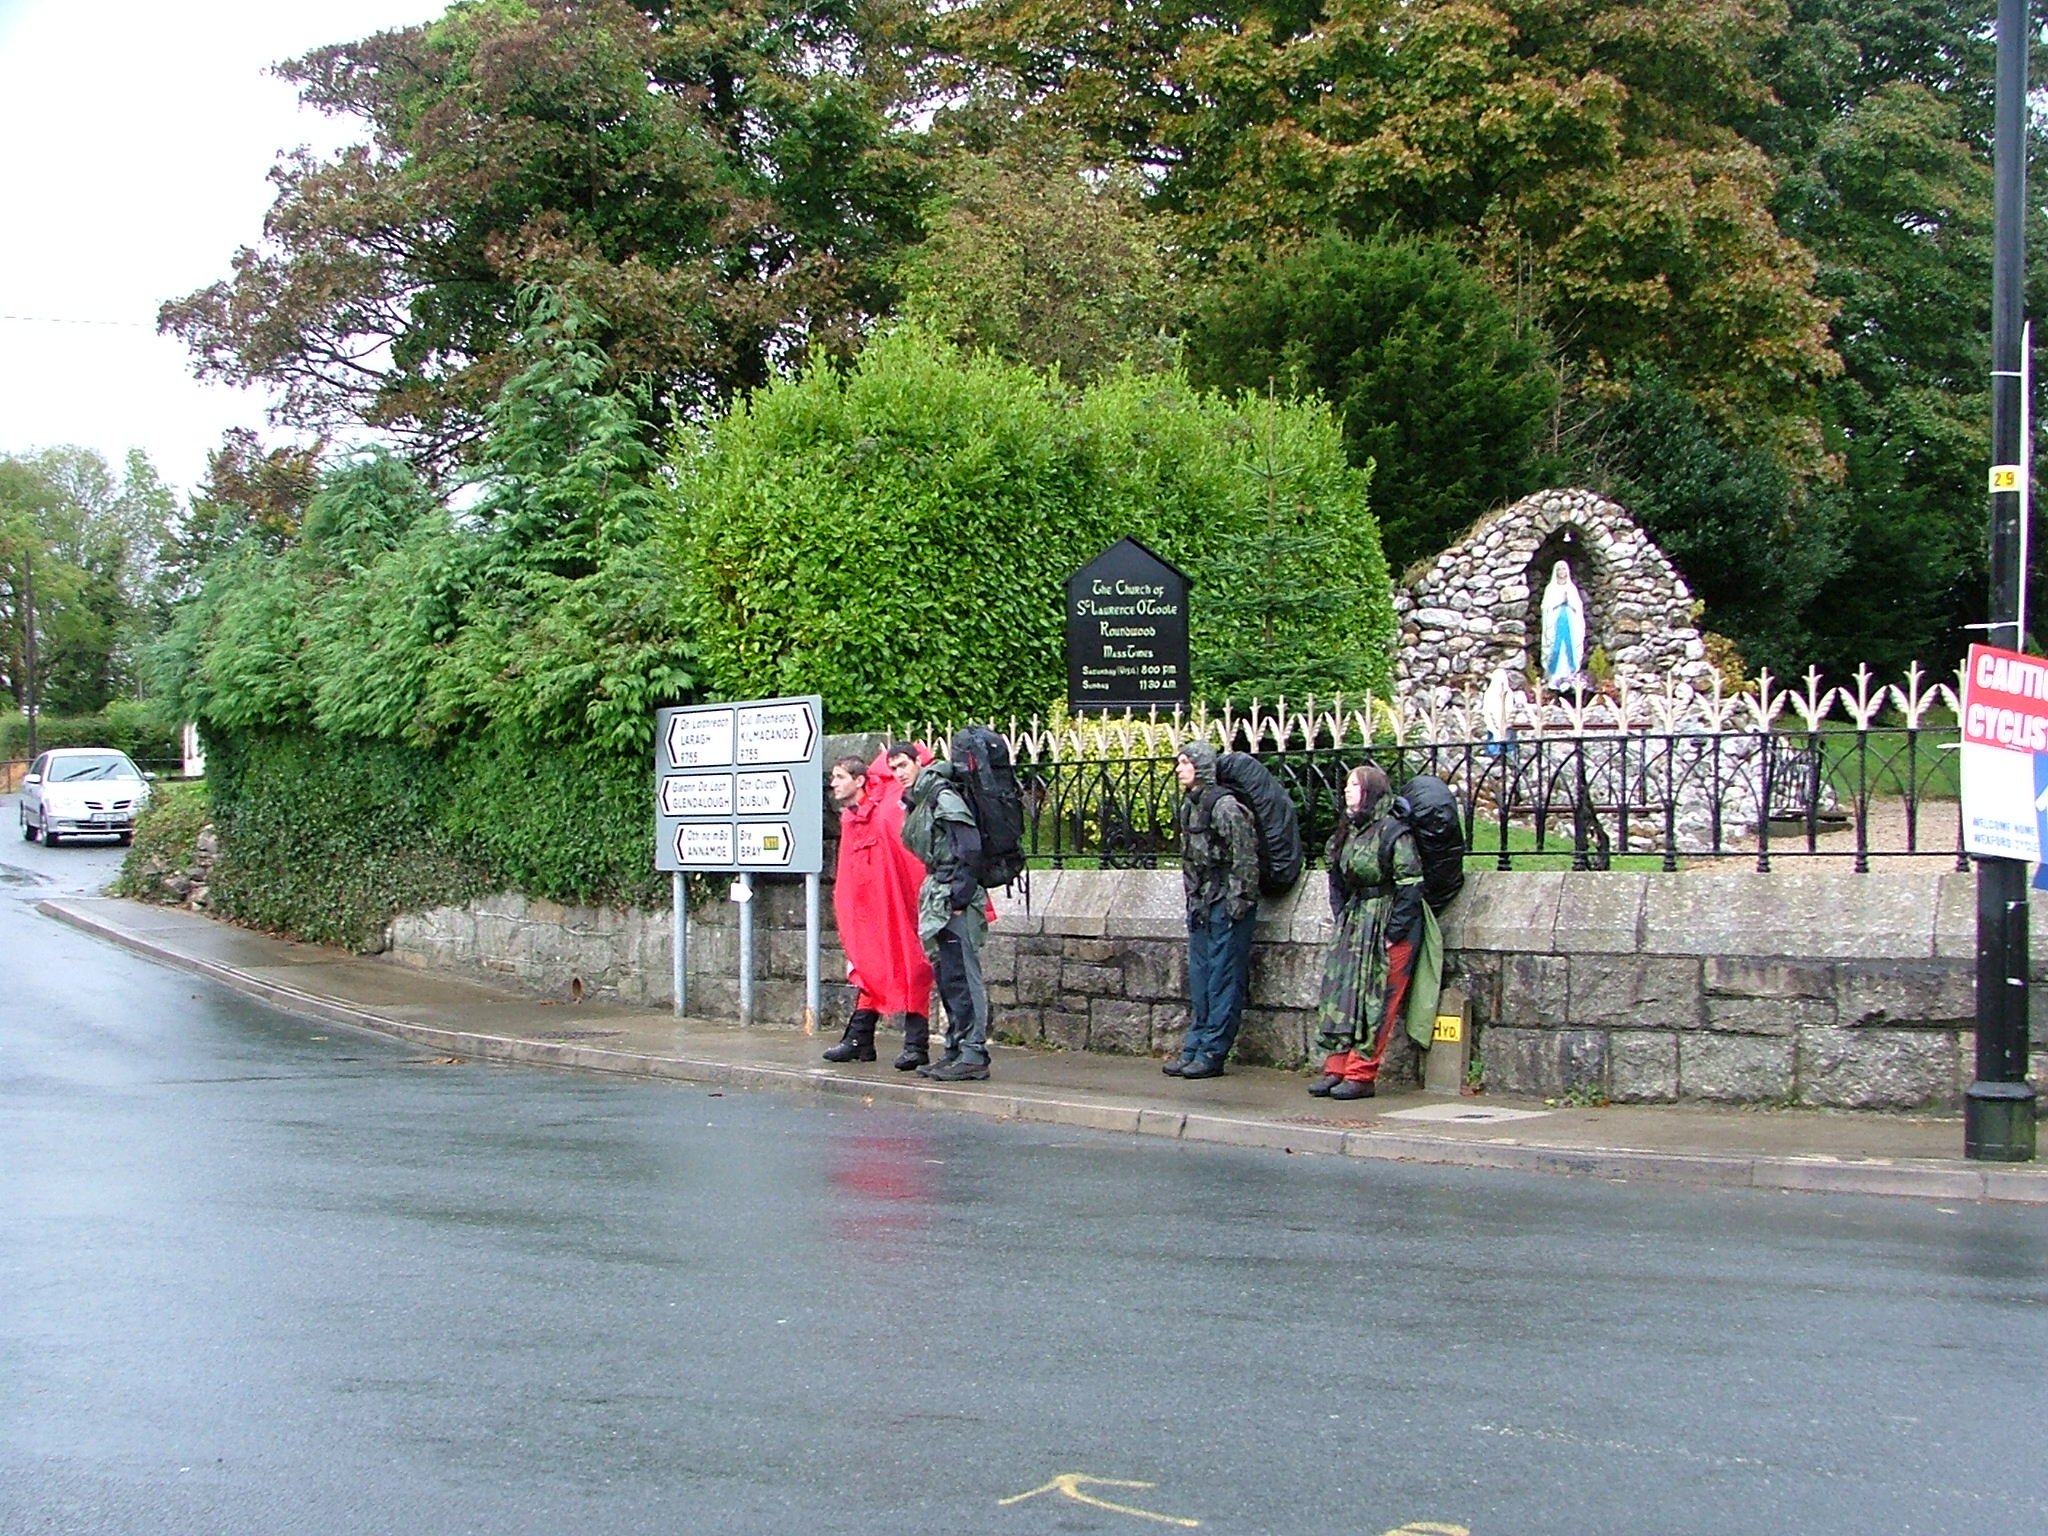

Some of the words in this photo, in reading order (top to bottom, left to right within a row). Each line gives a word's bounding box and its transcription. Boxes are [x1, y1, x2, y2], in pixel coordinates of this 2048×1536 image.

[1994, 472, 2015, 487] 29
[1092, 579, 1112, 595] The
[1115, 579, 1151, 595] Church
[1152, 586, 1164, 598] of
[672, 797, 730, 809] GLENDALOUGH
[739, 795, 770, 807] DUBLIN
[688, 846, 727, 858] ANNAMOE
[740, 846, 761, 857] BRAY
